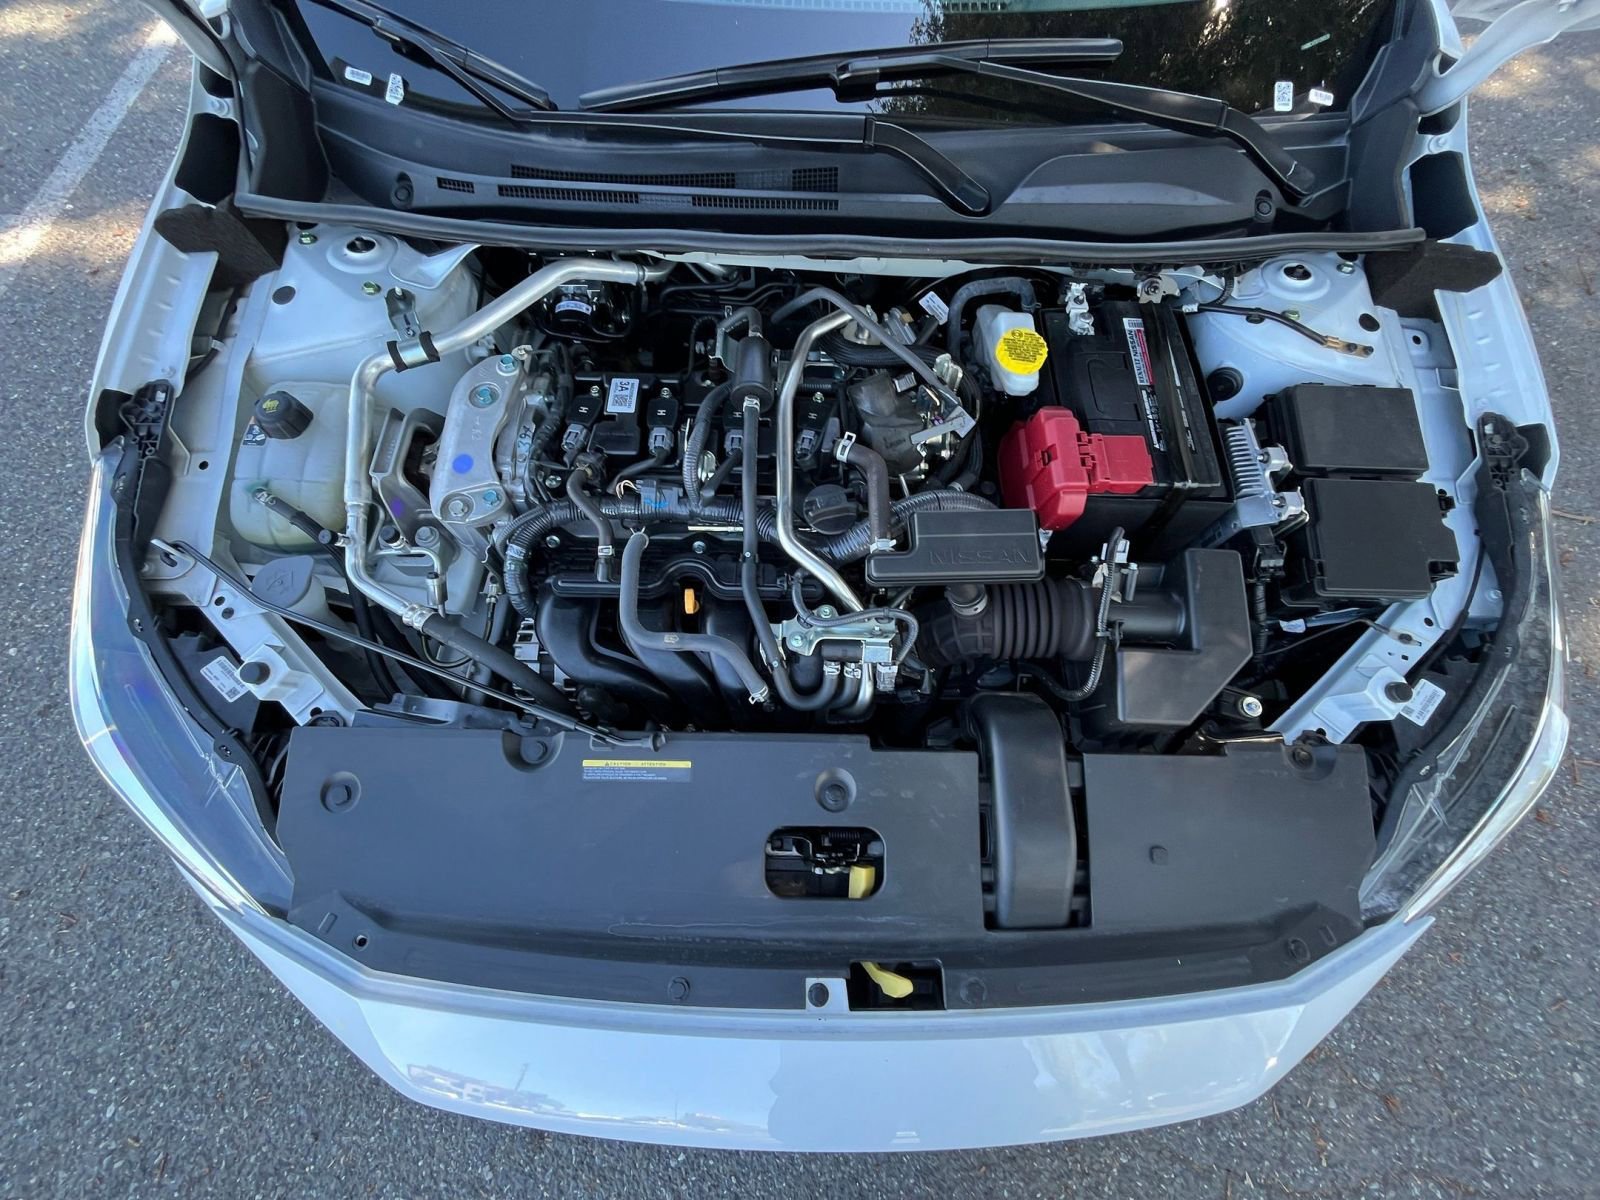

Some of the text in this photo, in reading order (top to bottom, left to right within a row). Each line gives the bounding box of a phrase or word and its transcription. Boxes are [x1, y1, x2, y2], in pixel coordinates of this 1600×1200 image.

[1127, 329, 1139, 357] NISSAN
[619, 381, 630, 392] 3A
[929, 548, 1033, 565] NISSAN
